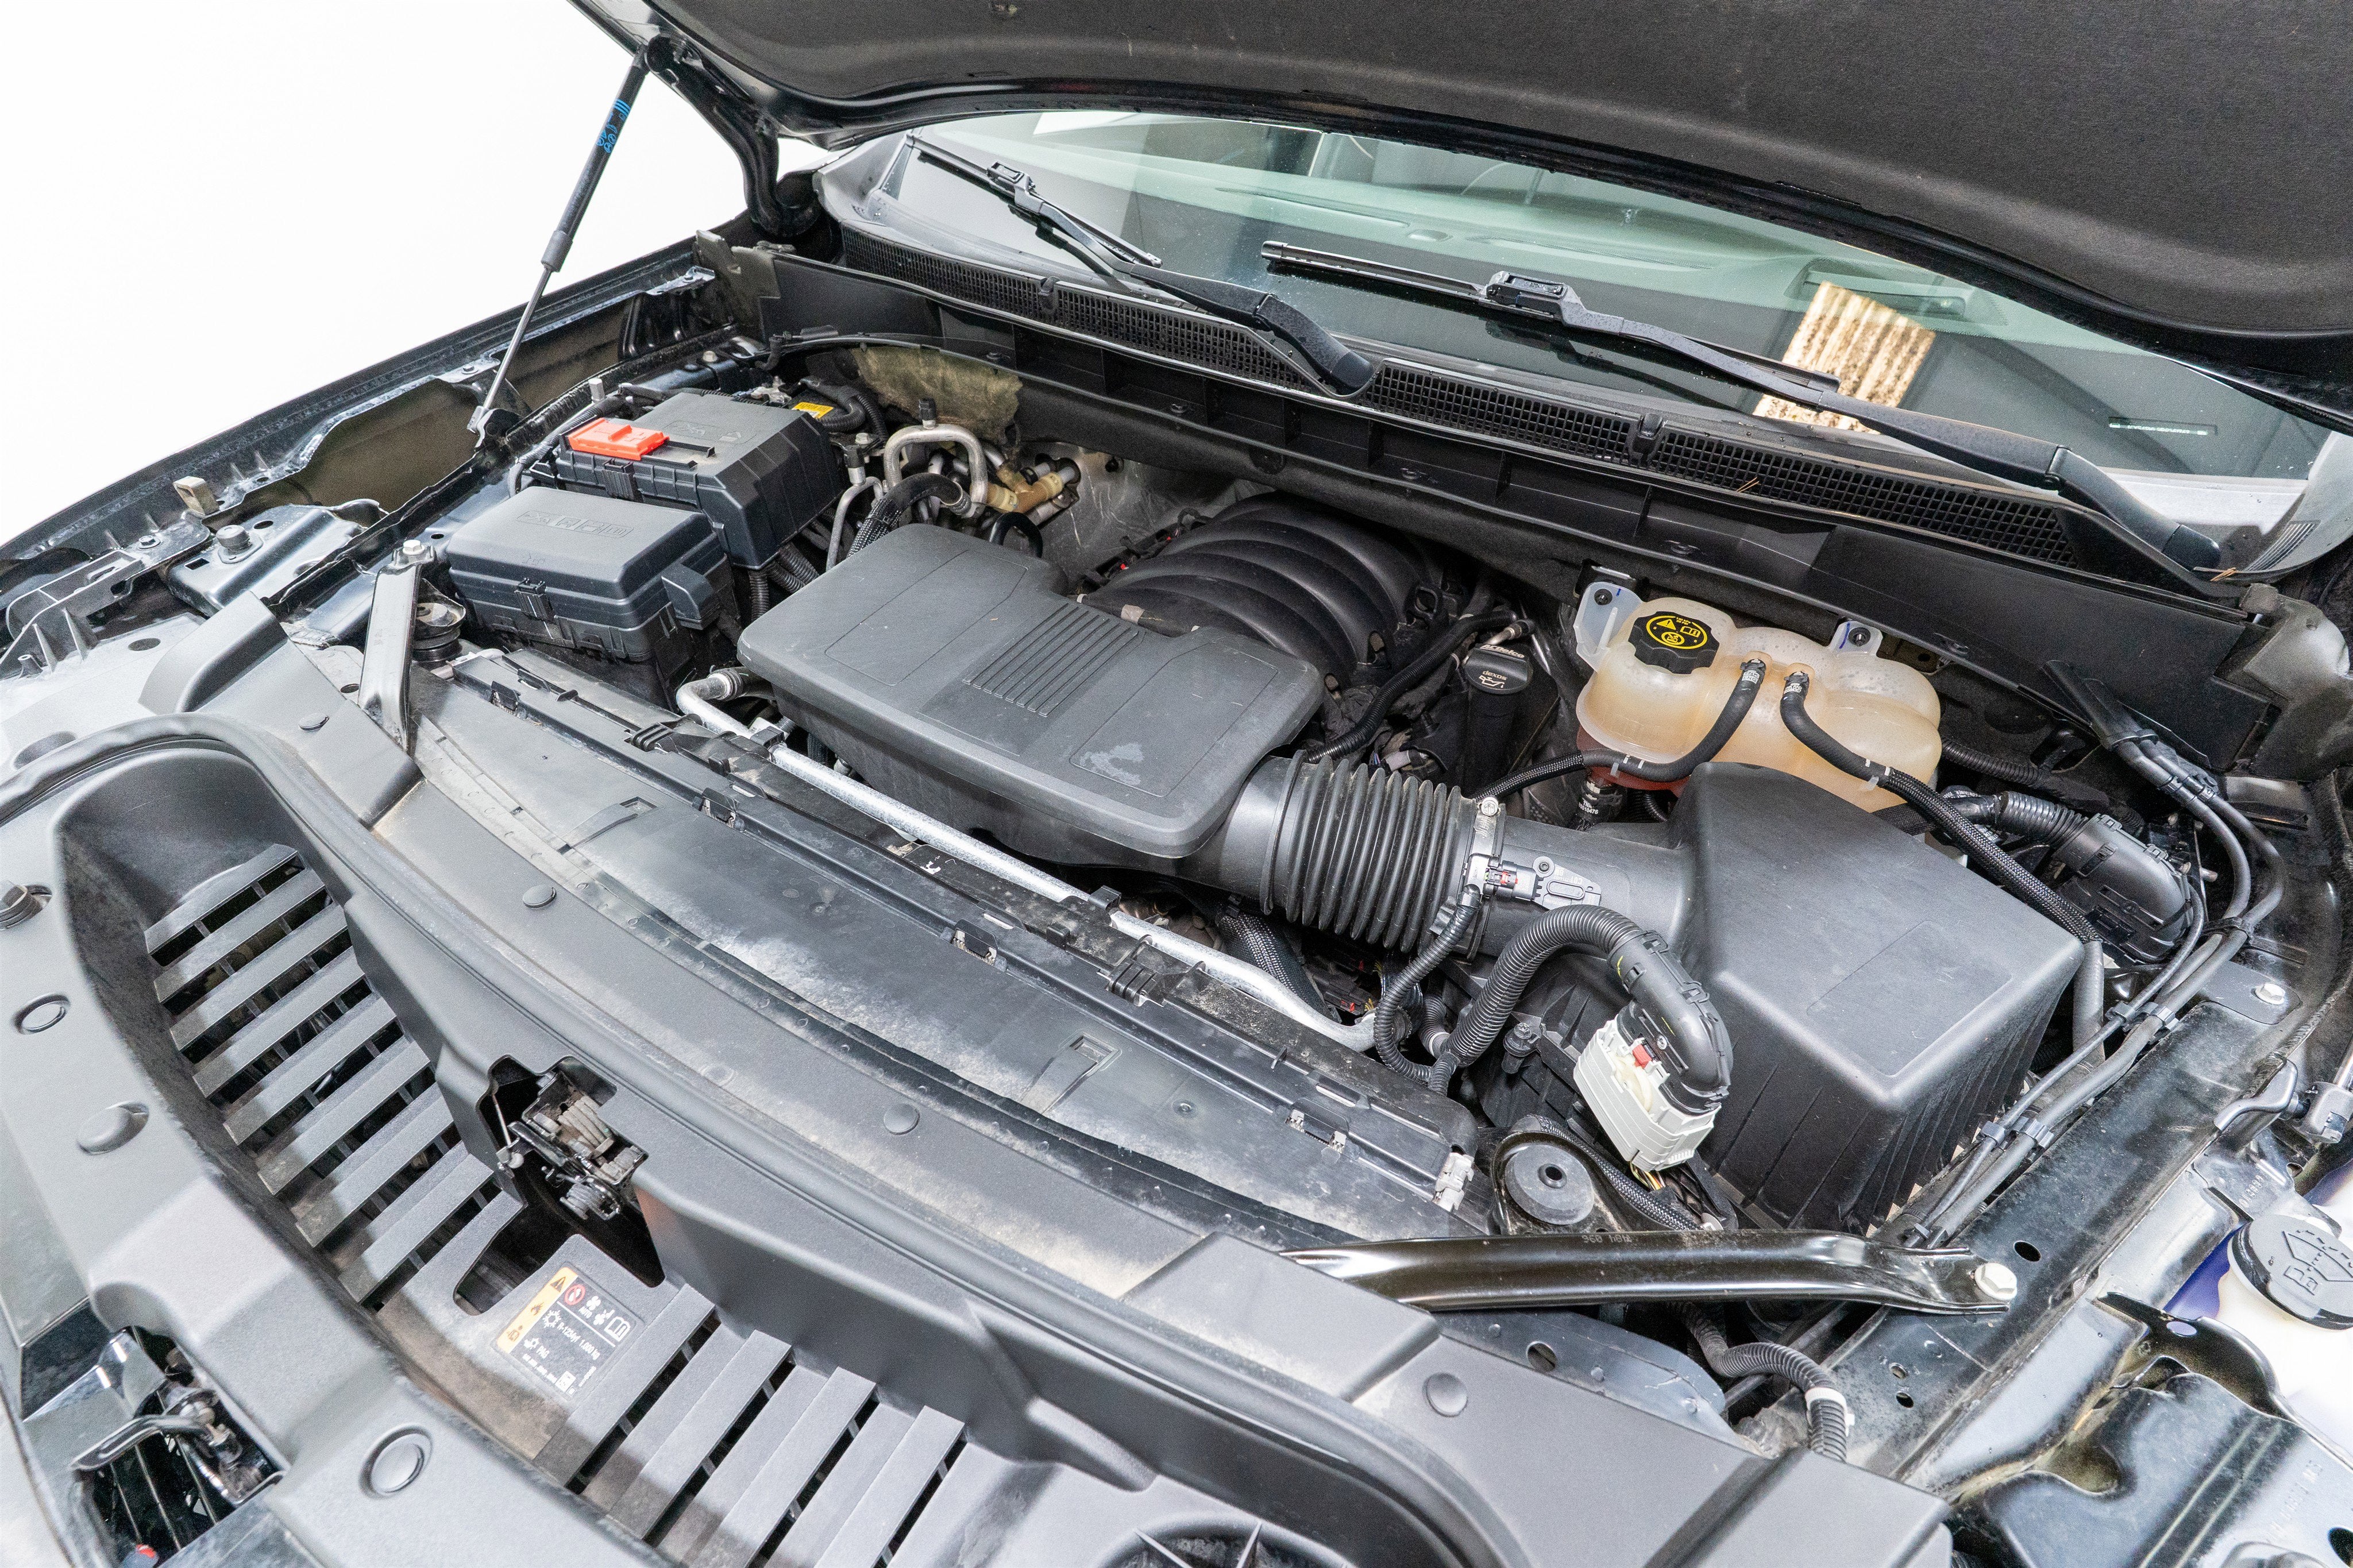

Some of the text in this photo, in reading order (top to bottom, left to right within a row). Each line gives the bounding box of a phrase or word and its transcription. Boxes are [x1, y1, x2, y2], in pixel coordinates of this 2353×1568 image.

[1479, 644, 1525, 658] ACDelco
[1483, 670, 1507, 681] dexos
[578, 1306, 593, 1318] AUTO
[557, 1322, 600, 1360] R-1234yf 1.000 kg
[536, 1346, 550, 1359] PAG
